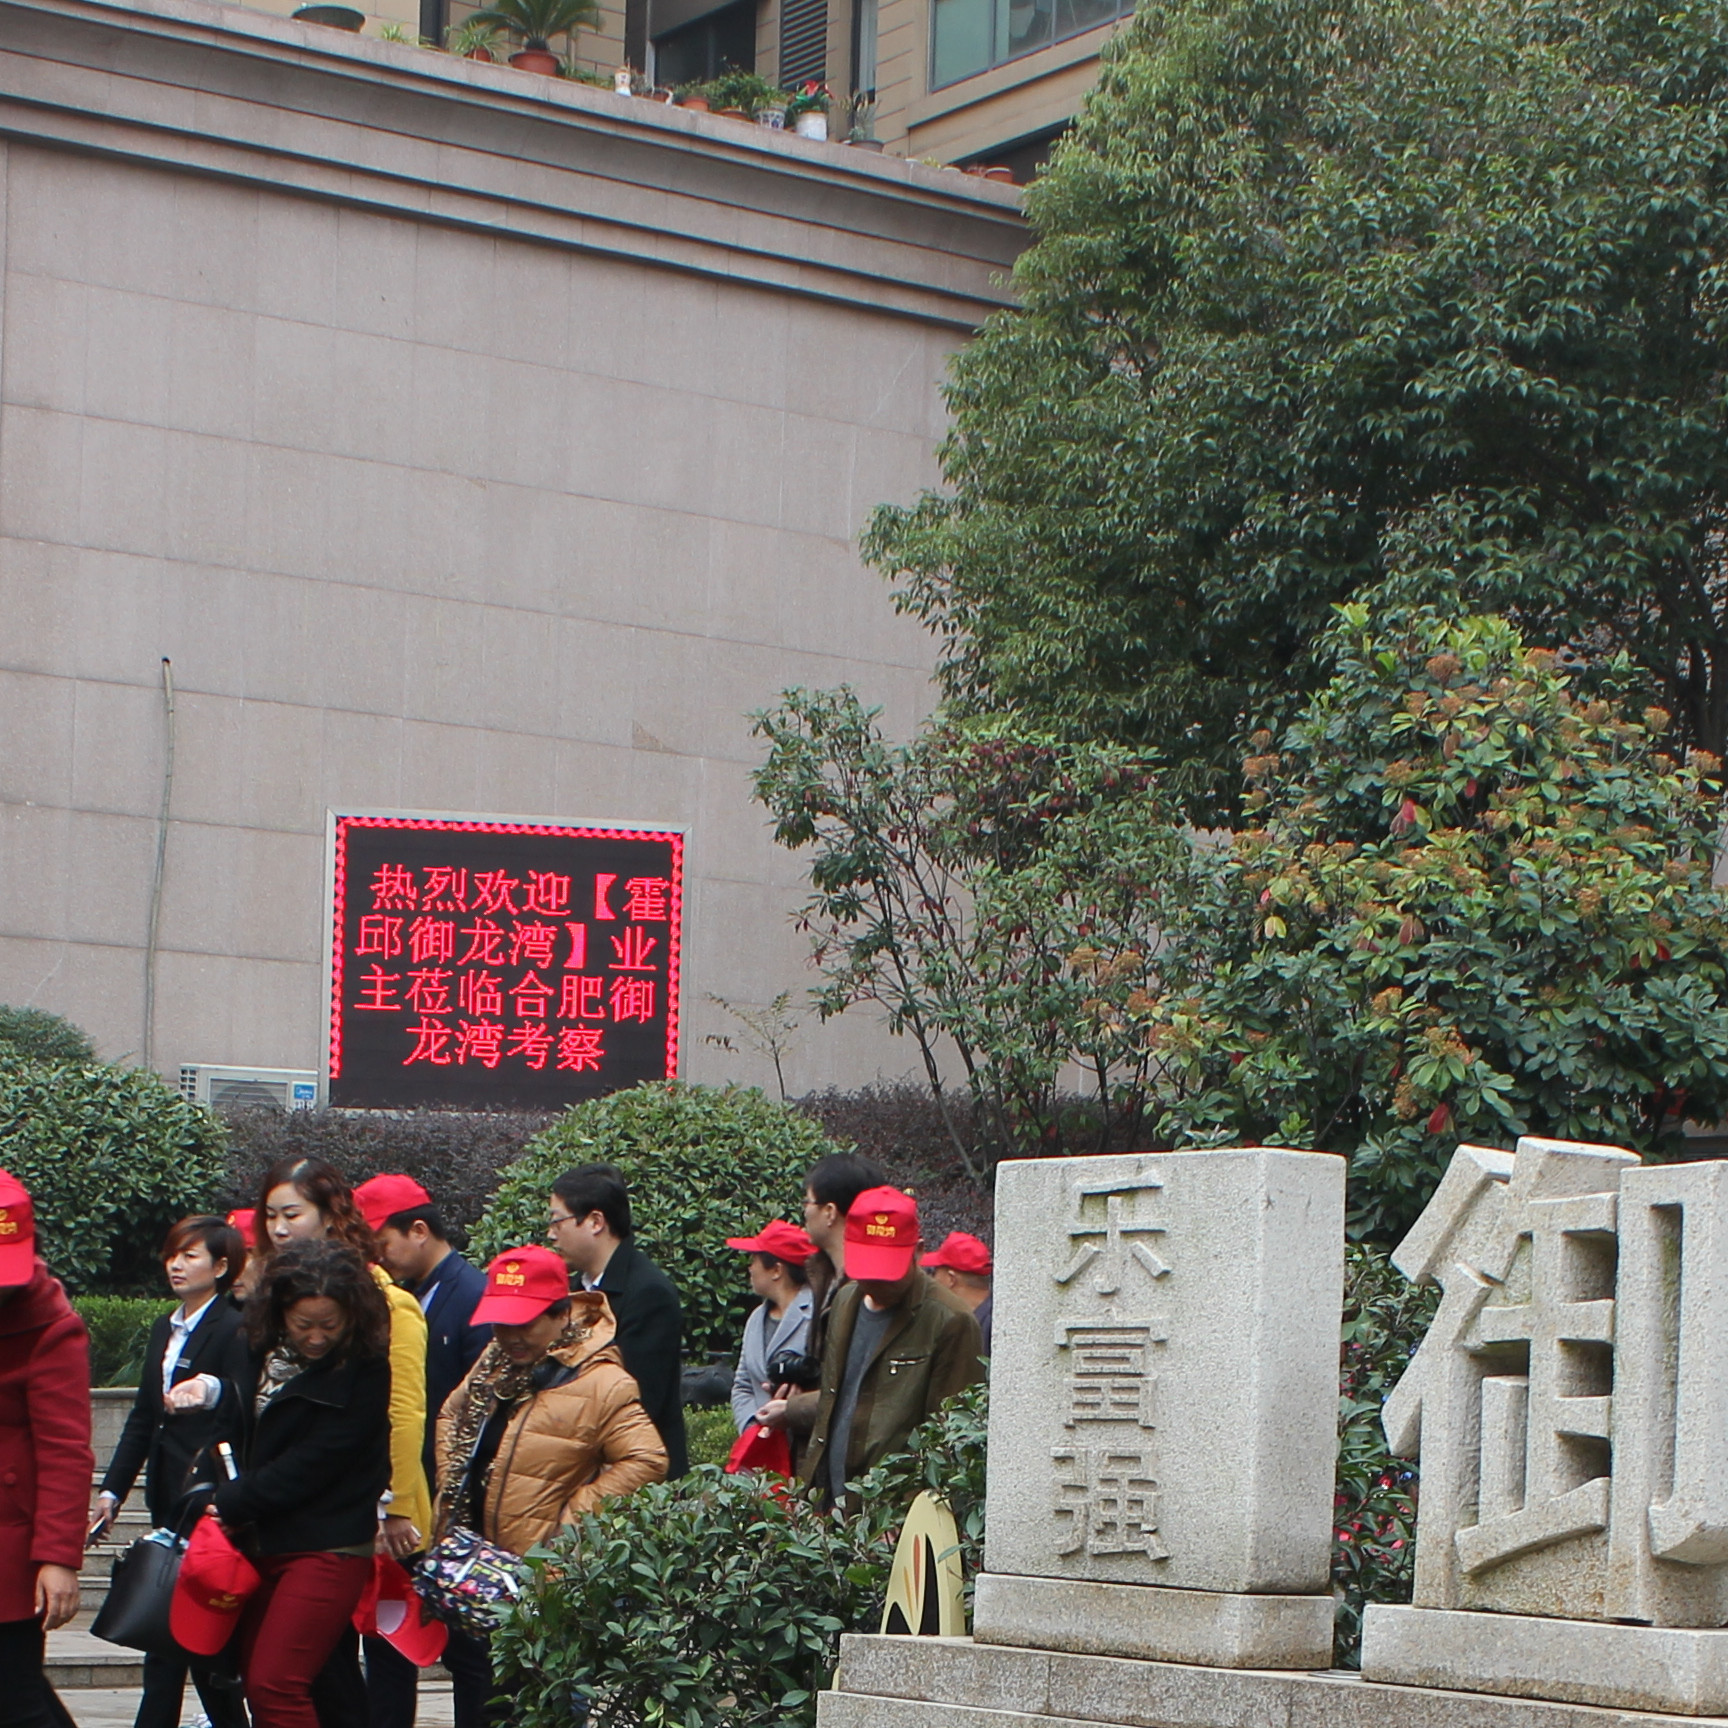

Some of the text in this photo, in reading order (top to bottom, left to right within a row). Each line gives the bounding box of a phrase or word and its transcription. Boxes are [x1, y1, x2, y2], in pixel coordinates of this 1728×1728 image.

[370, 863, 670, 921] 热烈欢迎【霍
[355, 914, 657, 971] 邱御龙湾】业
[354, 965, 655, 1023] 主莅临合肥御
[403, 1017, 604, 1072] 龙湾考察
